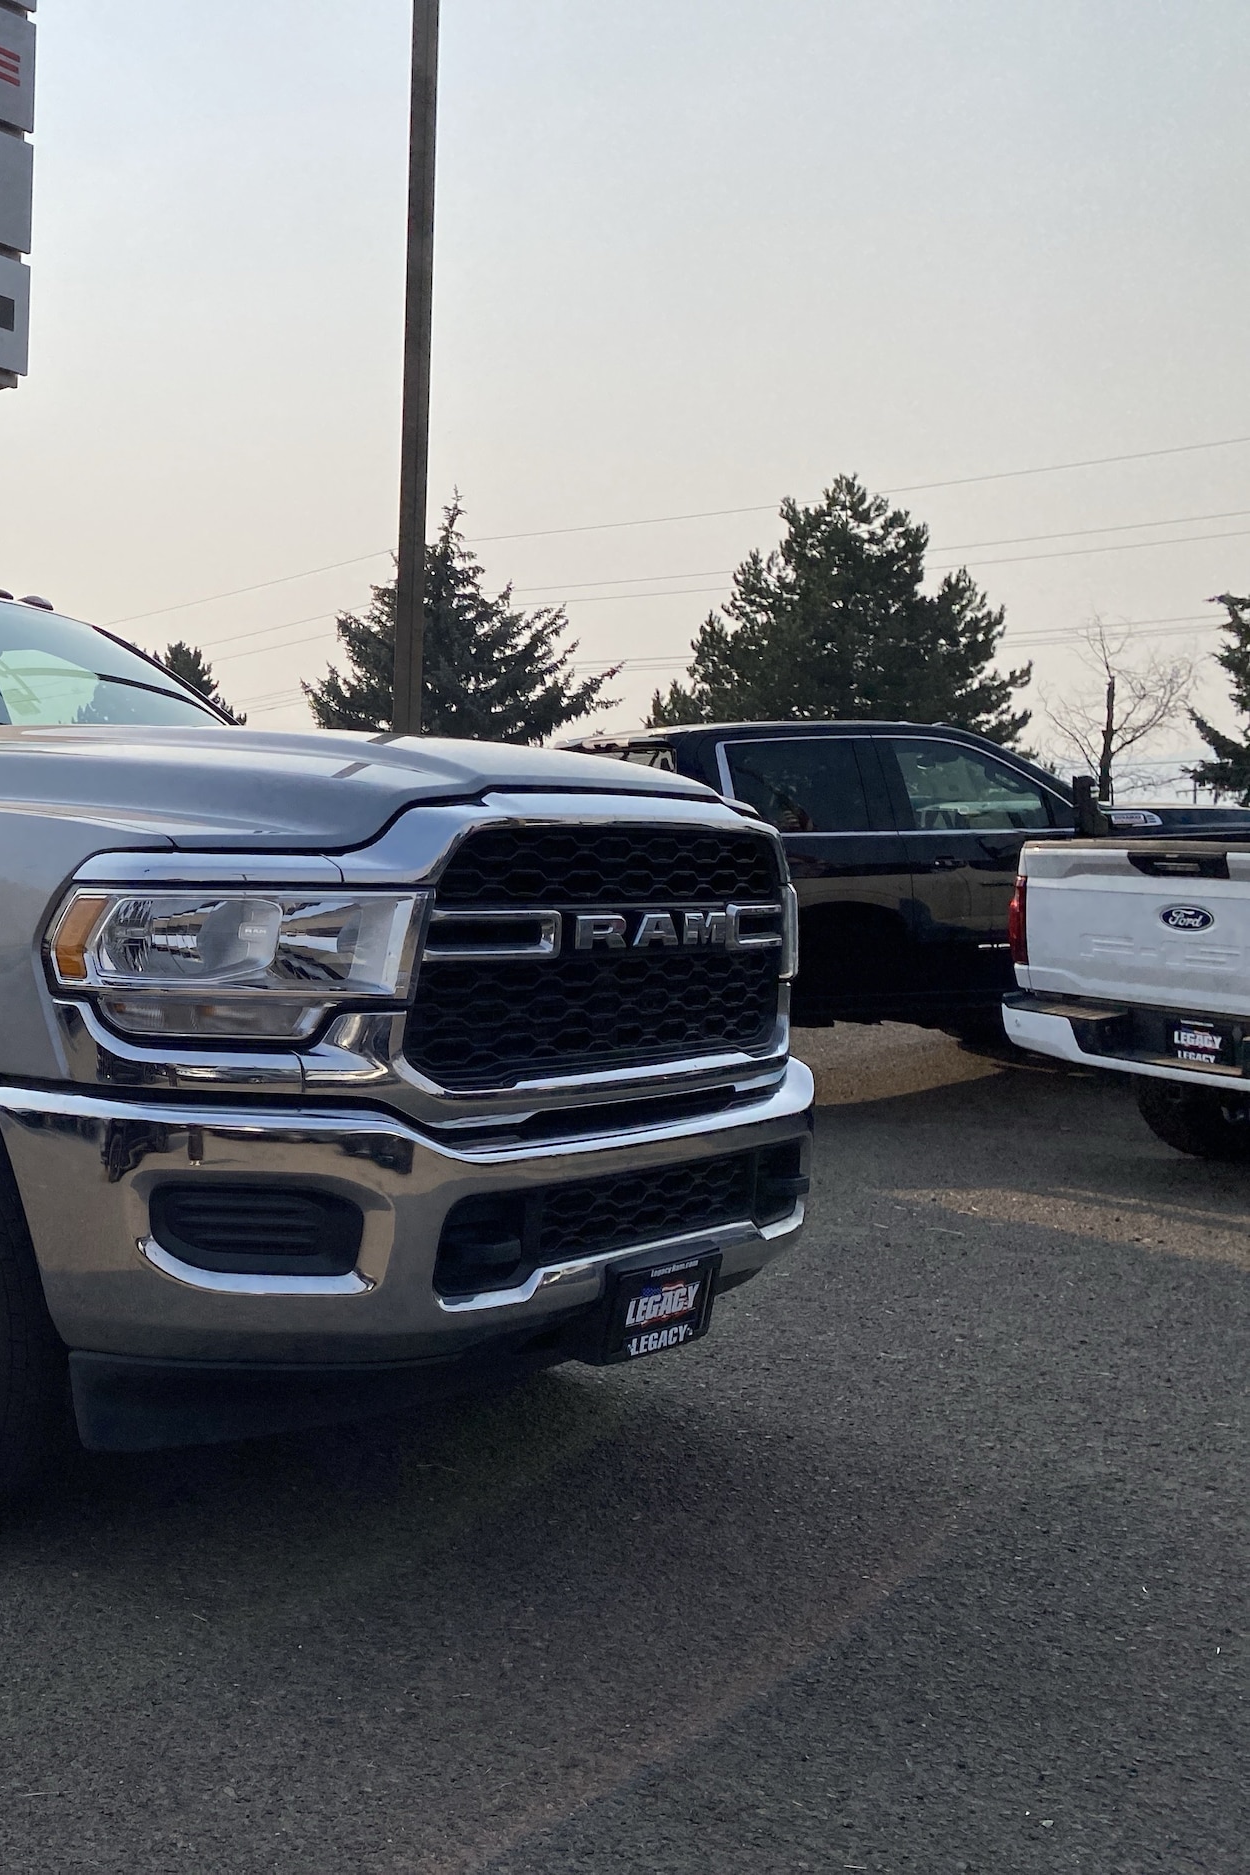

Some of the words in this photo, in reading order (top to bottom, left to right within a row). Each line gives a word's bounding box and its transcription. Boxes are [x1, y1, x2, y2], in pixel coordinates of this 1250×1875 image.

[575, 912, 727, 949] RAM
[1167, 909, 1205, 928] Ford
[1174, 1031, 1222, 1050] LEGACY
[1177, 1050, 1216, 1064] LEGACY
[625, 1282, 700, 1326] LEGACY
[630, 1324, 688, 1356] LEGACY
